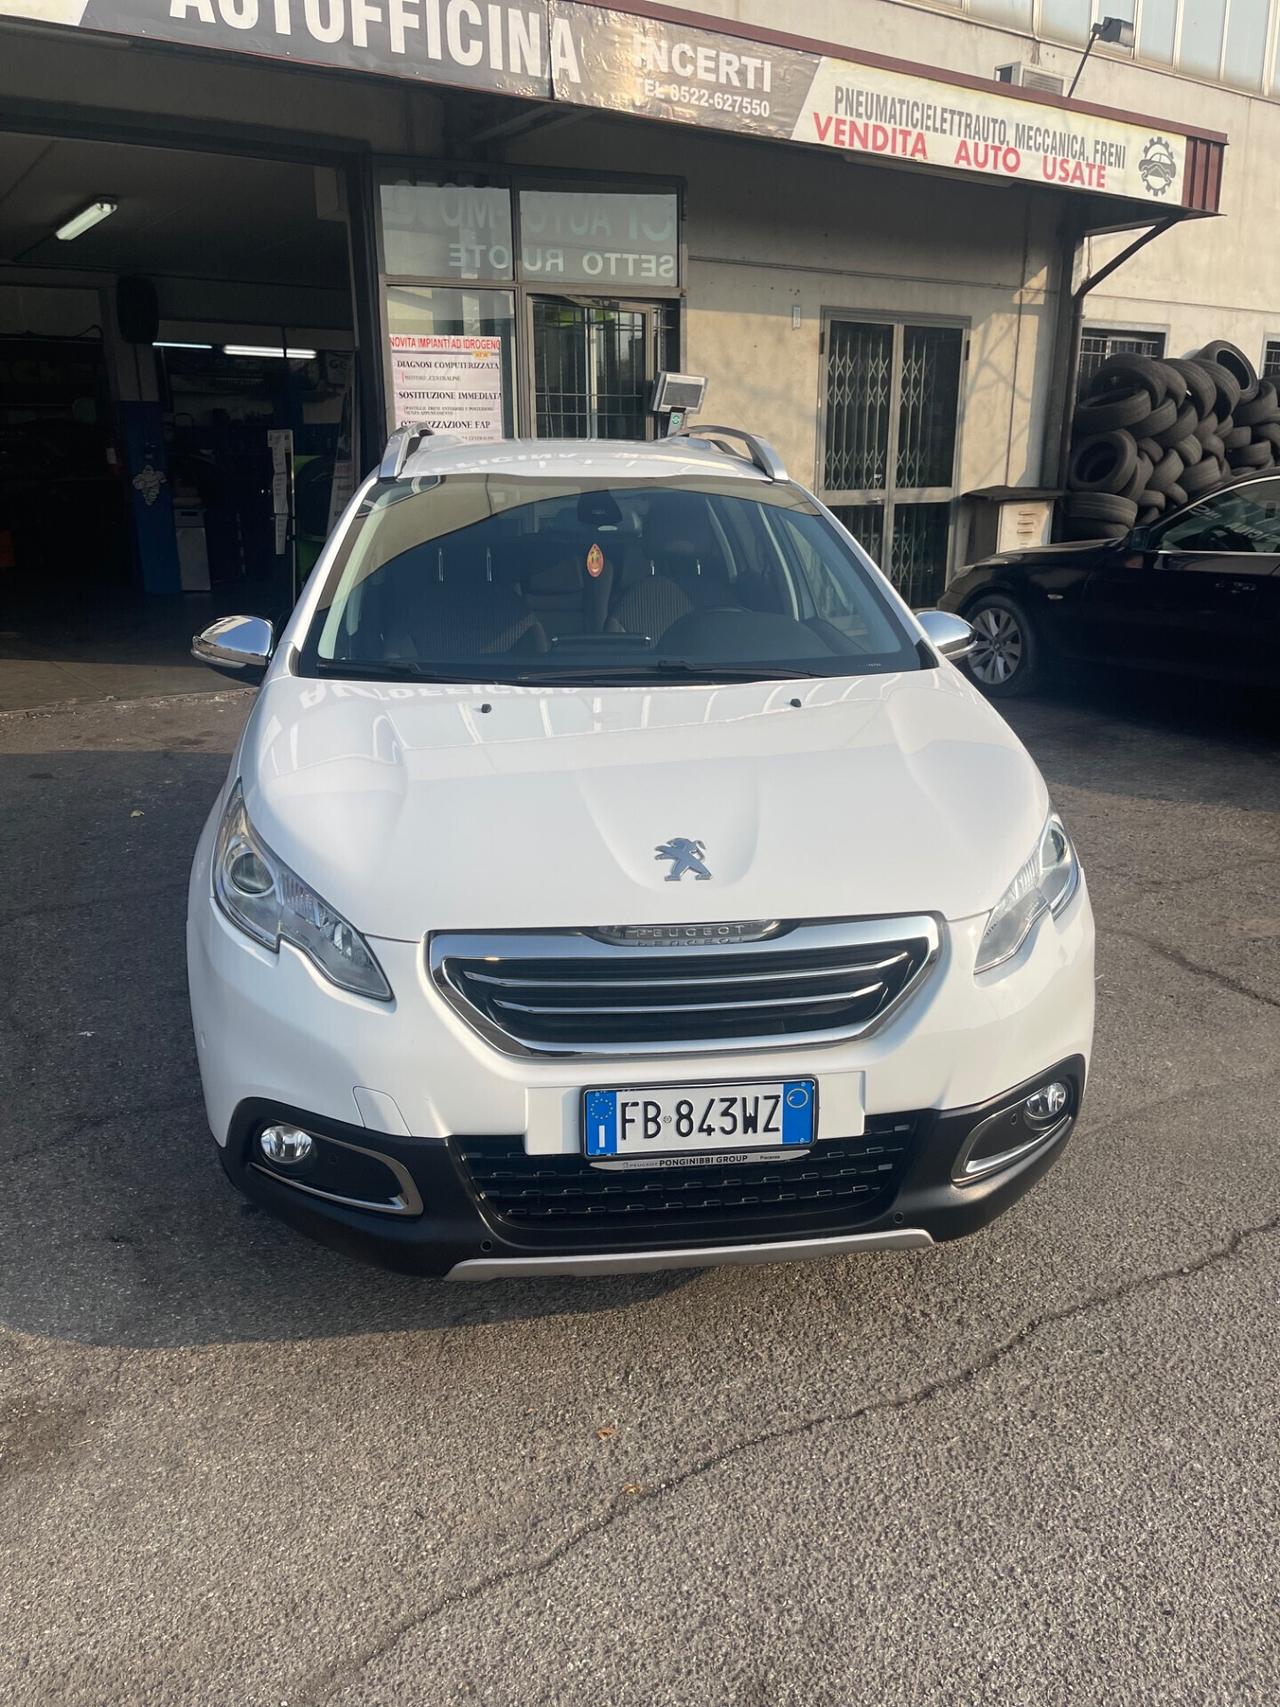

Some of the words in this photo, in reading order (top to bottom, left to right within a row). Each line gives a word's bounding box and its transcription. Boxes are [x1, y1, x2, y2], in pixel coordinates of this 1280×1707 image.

[632, 33, 771, 92] INCERTI
[813, 112, 928, 159] VENDITA
[954, 140, 1021, 173] AUTO
[1042, 155, 1106, 188] USATE
[1093, 139, 1126, 168] FRENI
[451, 339, 461, 349] AD
[399, 391, 456, 400] SOSTITUZIONE
[458, 392, 501, 400] IMMEDIATA
[400, 421, 473, 429] OZZAZIONE
[475, 421, 491, 429] FAP
[636, 925, 745, 938] PEUGEOT
[621, 1100, 662, 1140] FB
[675, 1094, 781, 1138] 843WZ
[659, 1156, 714, 1167] PONGINIBBI
[716, 1155, 748, 1164] GROUP
